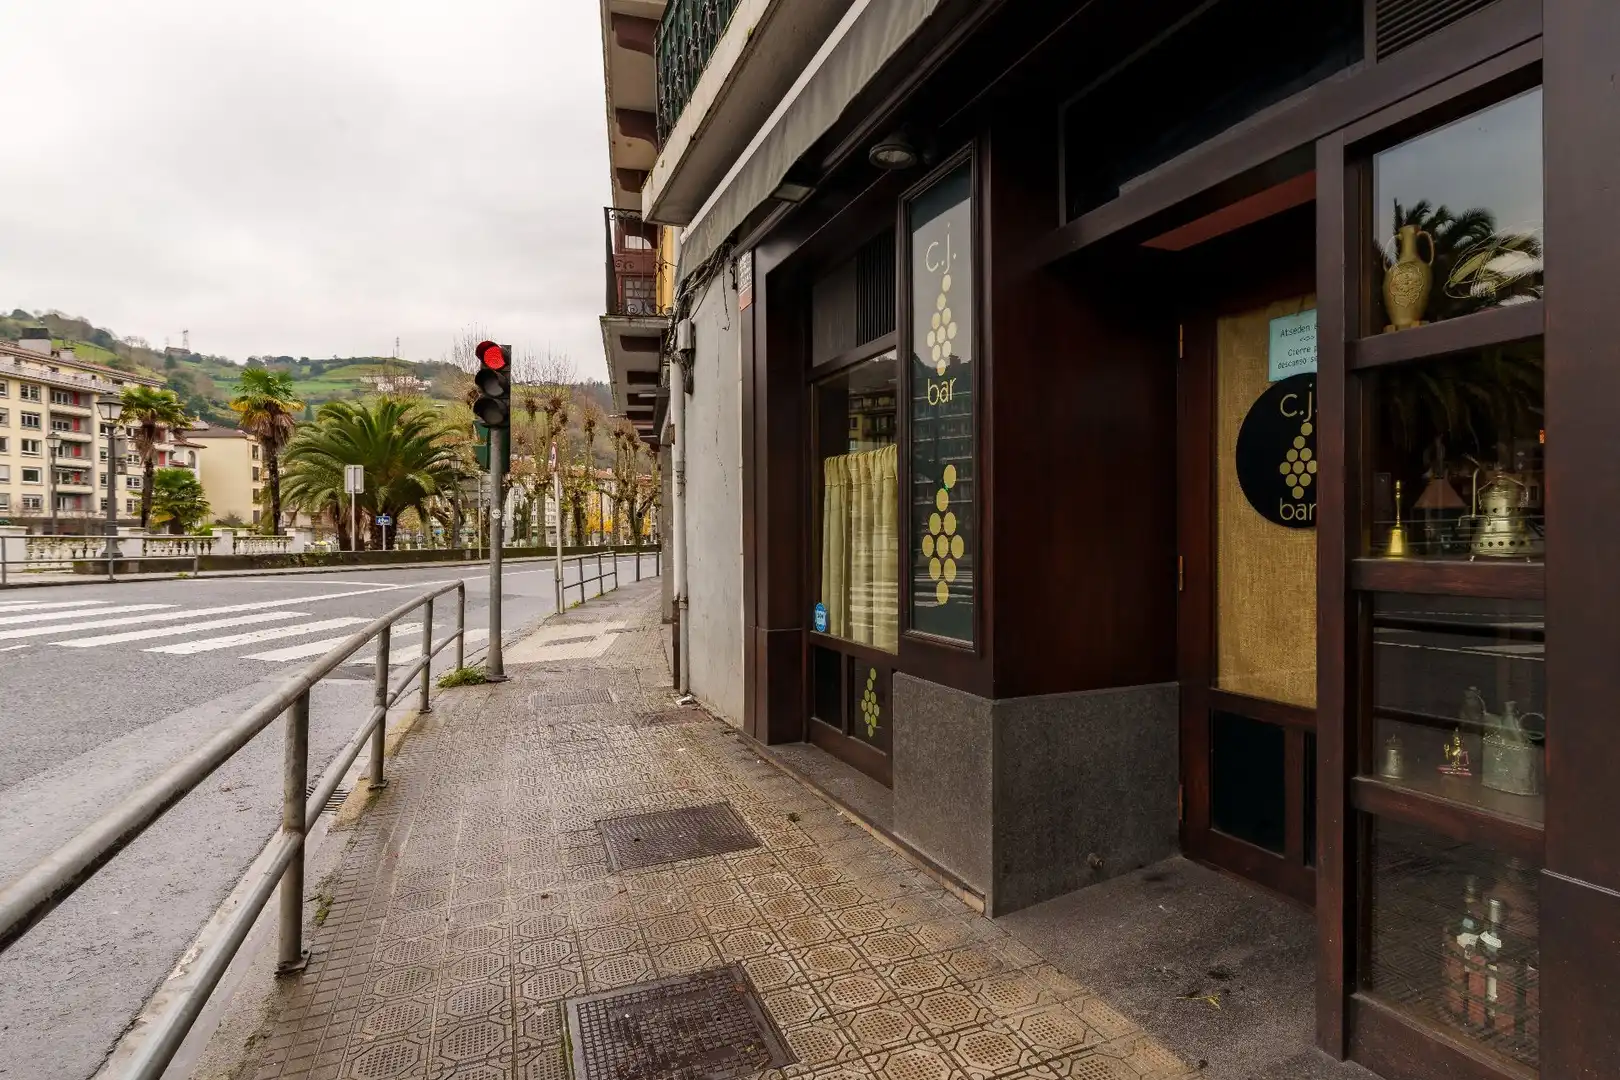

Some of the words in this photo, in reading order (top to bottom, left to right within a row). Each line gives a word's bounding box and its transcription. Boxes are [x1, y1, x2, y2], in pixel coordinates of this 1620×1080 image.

[1287, 346, 1311, 357] Cierre
[927, 377, 957, 406] bar
[1279, 497, 1317, 521] bar
